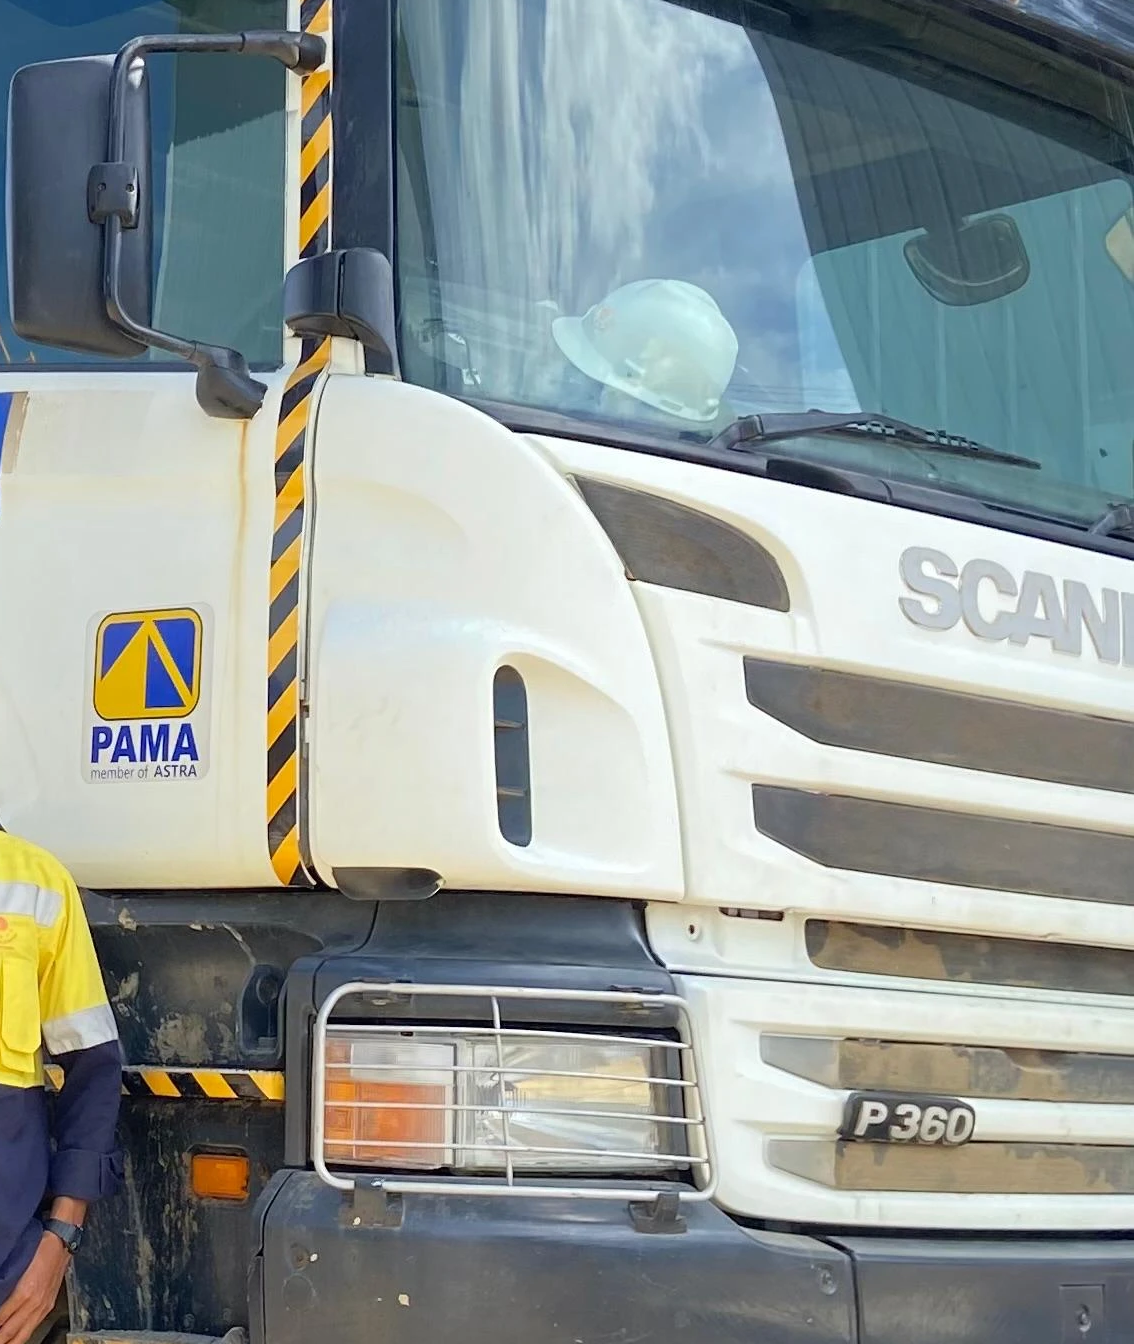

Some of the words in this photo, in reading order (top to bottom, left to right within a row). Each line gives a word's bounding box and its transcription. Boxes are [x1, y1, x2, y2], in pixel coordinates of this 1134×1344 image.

[90, 723, 199, 764] PAMA
[90, 766, 134, 780] member
[137, 765, 149, 780] of
[154, 764, 197, 777] ASTRA
[854, 1100, 889, 1136] P
[889, 1103, 974, 1143] 360
